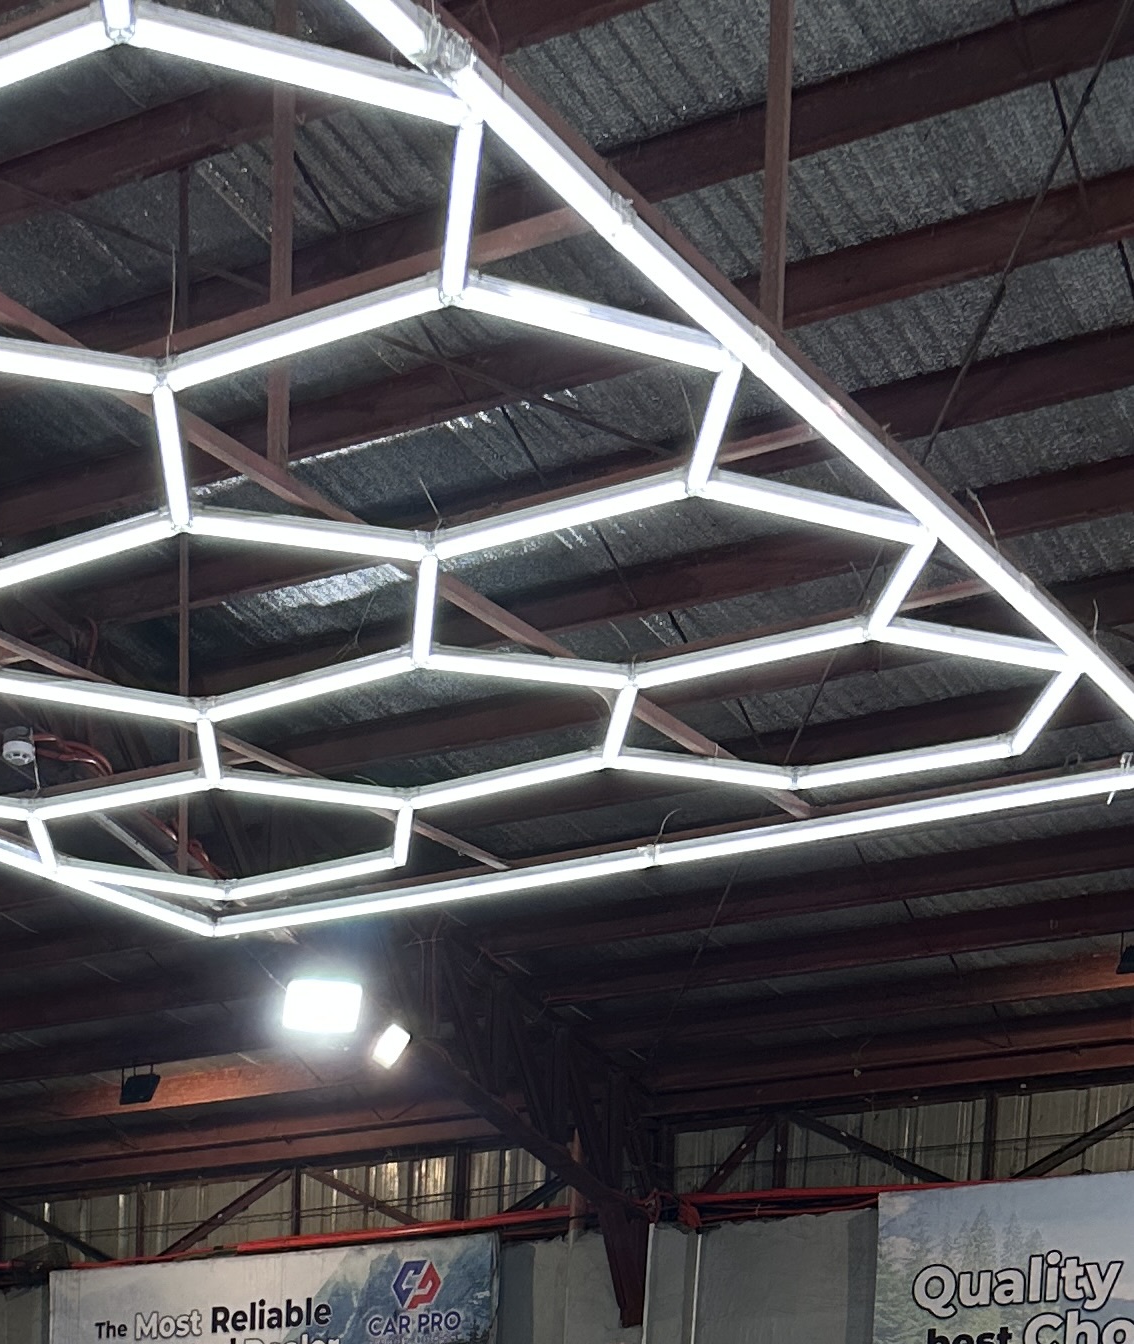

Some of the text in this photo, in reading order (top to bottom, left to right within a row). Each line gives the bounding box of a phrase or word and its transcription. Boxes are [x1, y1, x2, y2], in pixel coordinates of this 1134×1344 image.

[912, 1249, 1124, 1319] Quality
[94, 1297, 332, 1341] The Most Reliable
[368, 1311, 461, 1337] CAR PRO
